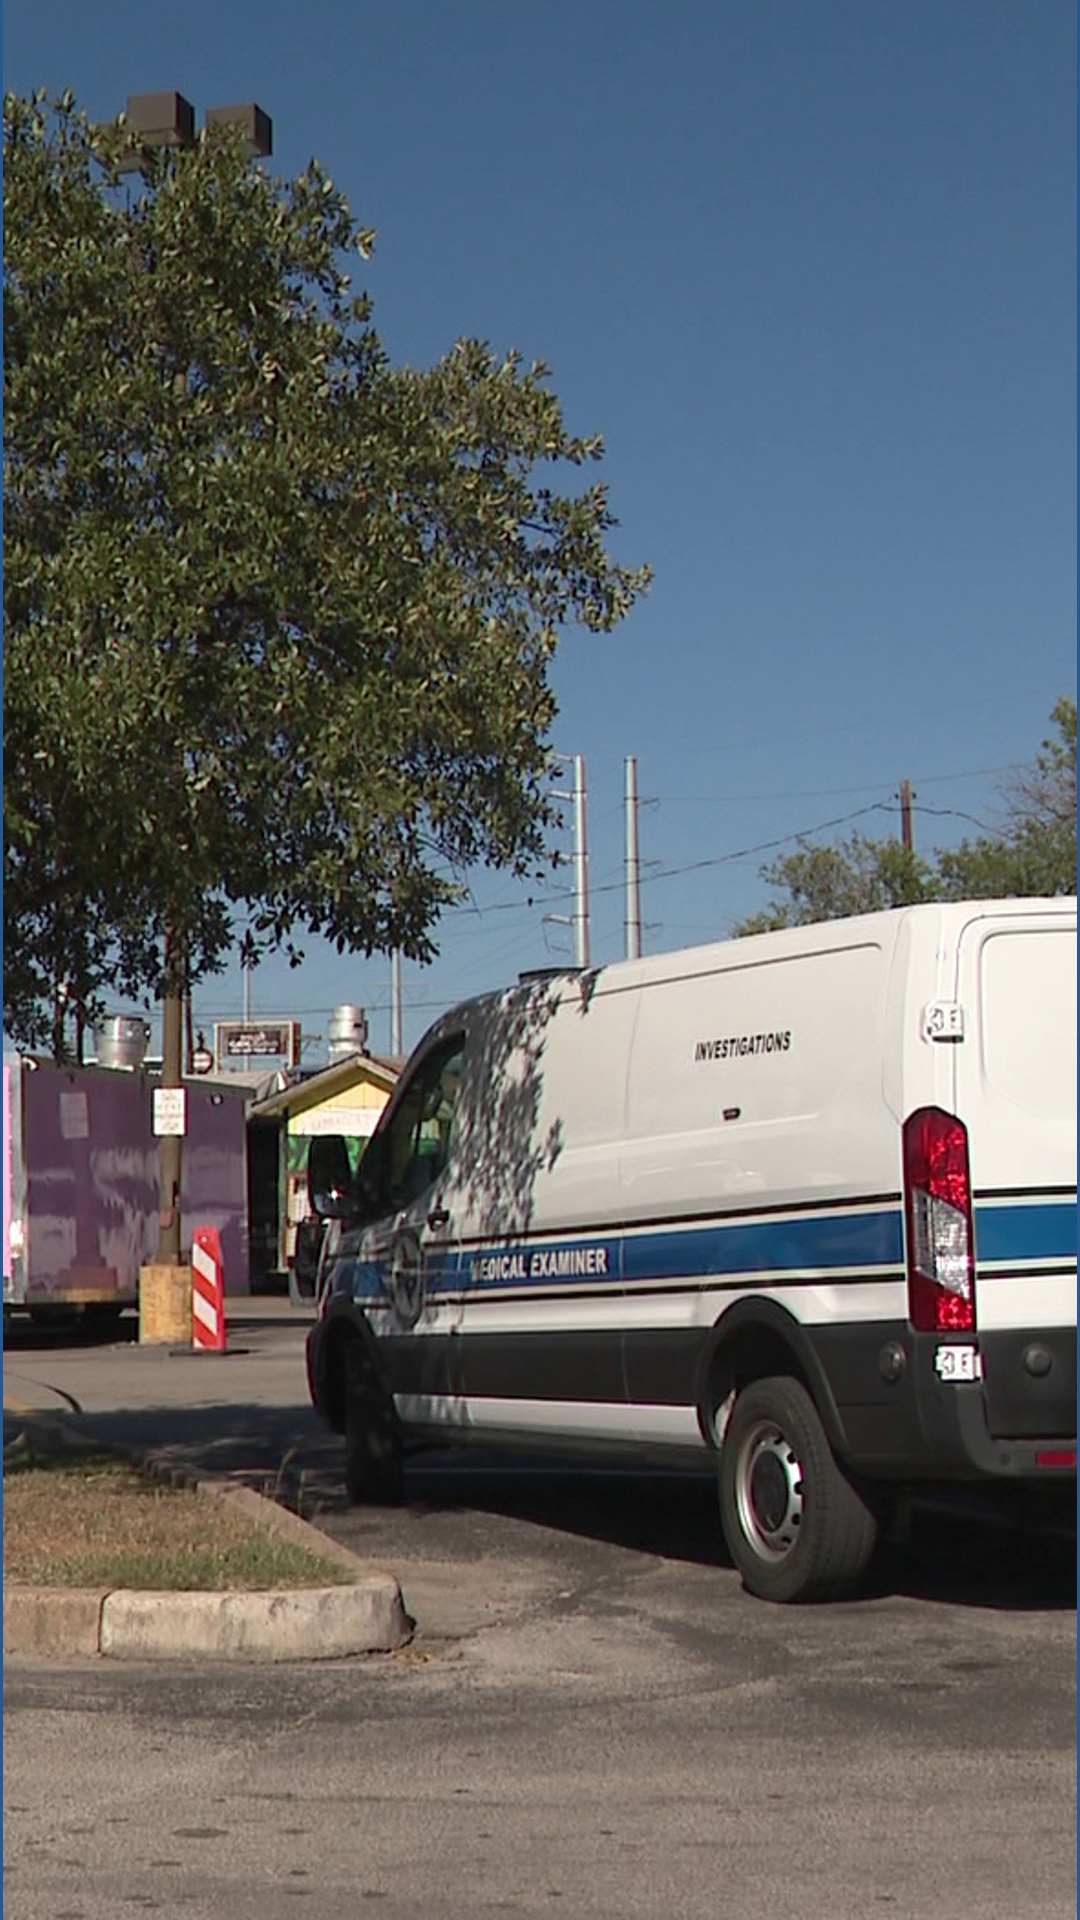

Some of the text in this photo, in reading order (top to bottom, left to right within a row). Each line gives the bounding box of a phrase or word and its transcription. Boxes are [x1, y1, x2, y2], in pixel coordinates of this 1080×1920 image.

[695, 1031, 791, 1060] INVESTIGATIONS
[470, 1248, 607, 1281] MEDICAL EXAMINER
